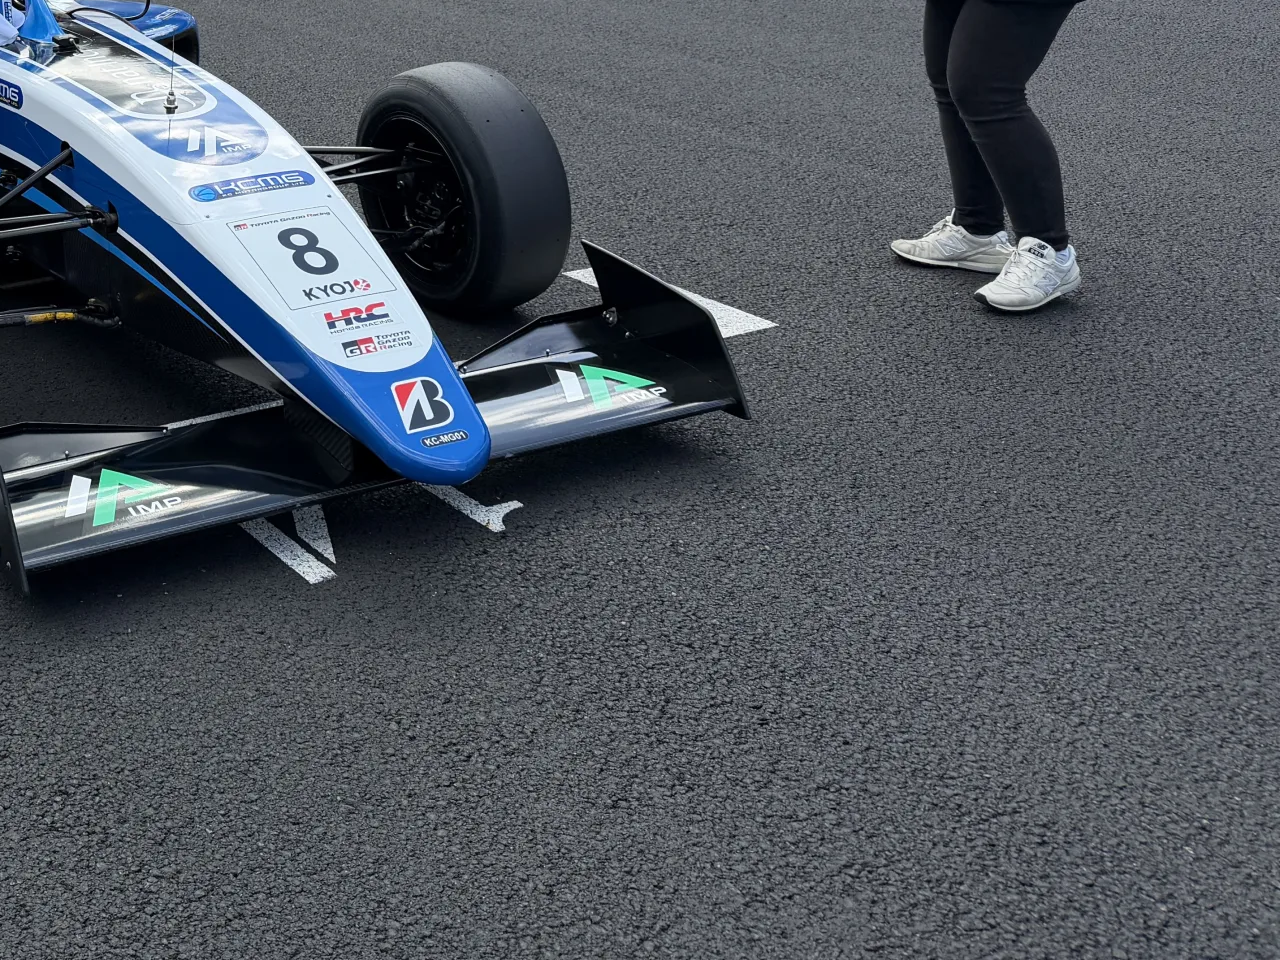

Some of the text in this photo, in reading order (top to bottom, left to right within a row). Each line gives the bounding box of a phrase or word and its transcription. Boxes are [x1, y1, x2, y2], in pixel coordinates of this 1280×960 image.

[222, 142, 253, 154] IMP
[217, 172, 305, 195] KCMG
[249, 219, 279, 228] TOYOTA
[280, 215, 306, 223] GAZOO
[277, 227, 340, 275] 8
[324, 302, 390, 330] HRC
[329, 318, 394, 335] Honda RACING
[374, 330, 411, 340] TOYOTA
[343, 339, 378, 358] GR
[377, 335, 411, 345] GAZOO
[379, 340, 413, 351] Racing
[621, 386, 667, 403] IMP
[423, 431, 466, 447] KC-MG01
[127, 496, 182, 517] IMP
